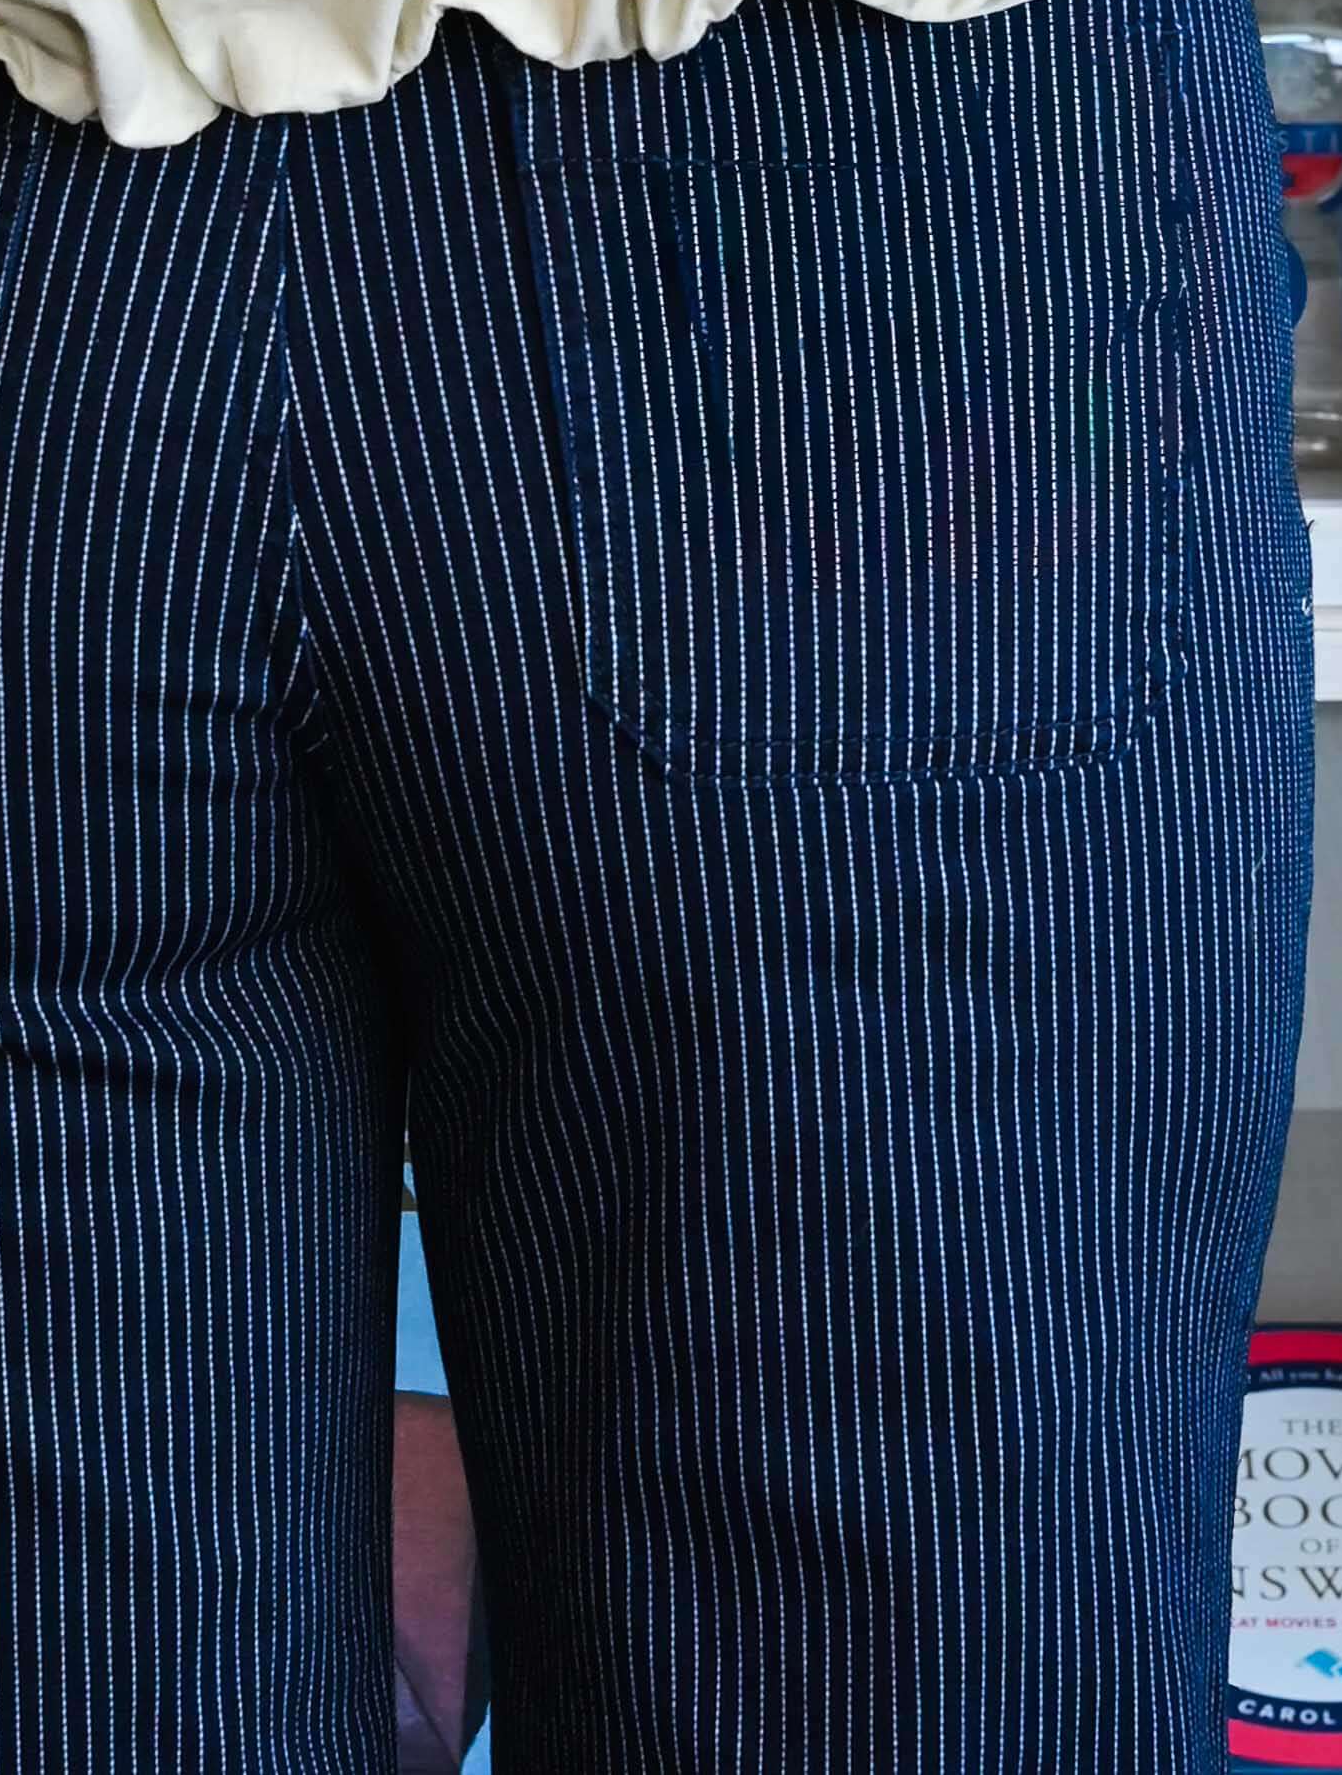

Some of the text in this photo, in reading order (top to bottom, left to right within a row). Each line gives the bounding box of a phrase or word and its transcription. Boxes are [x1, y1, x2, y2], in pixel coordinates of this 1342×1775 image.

[1299, 1537, 1340, 1554] OF
[1265, 1617, 1338, 1630] MOVIES
[1237, 1698, 1336, 1726] CAROL
